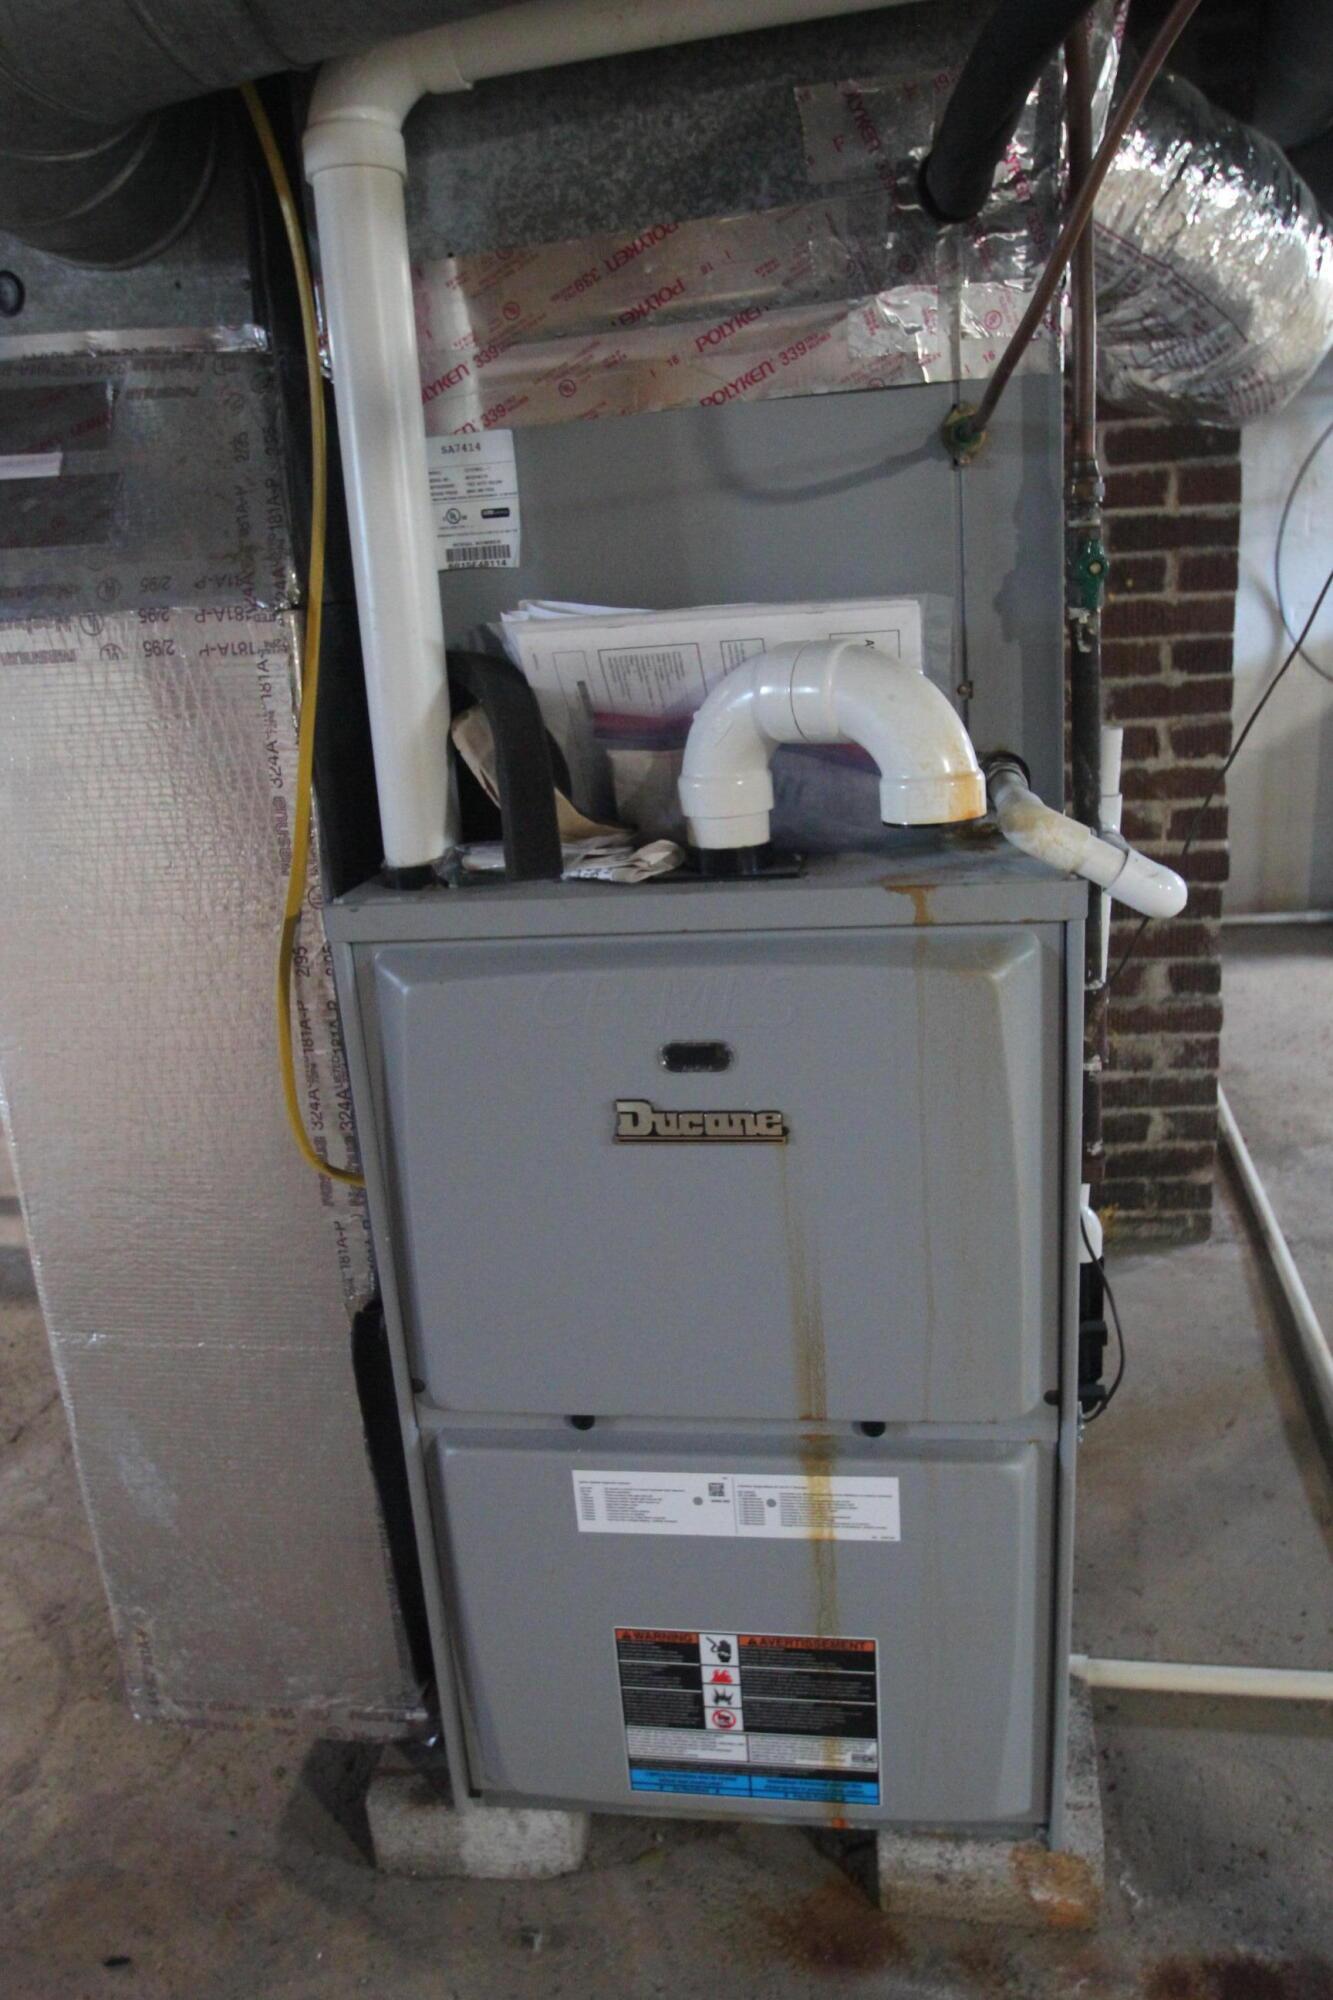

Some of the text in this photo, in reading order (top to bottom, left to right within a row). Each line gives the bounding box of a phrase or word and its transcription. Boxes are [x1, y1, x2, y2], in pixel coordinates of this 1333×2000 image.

[610, 277, 685, 326] POLYKE
[695, 305, 768, 352] POLYKE
[473, 345, 500, 368] 339
[779, 341, 807, 366] 339
[440, 442, 482, 455] SA7414
[138, 608, 169, 623] 2/95
[142, 639, 174, 657] 2/95
[294, 946, 310, 978] 2/95
[308, 1088, 325, 1131] 324A
[335, 1087, 353, 1131] 324A
[616, 1099, 783, 1138] Ducane
